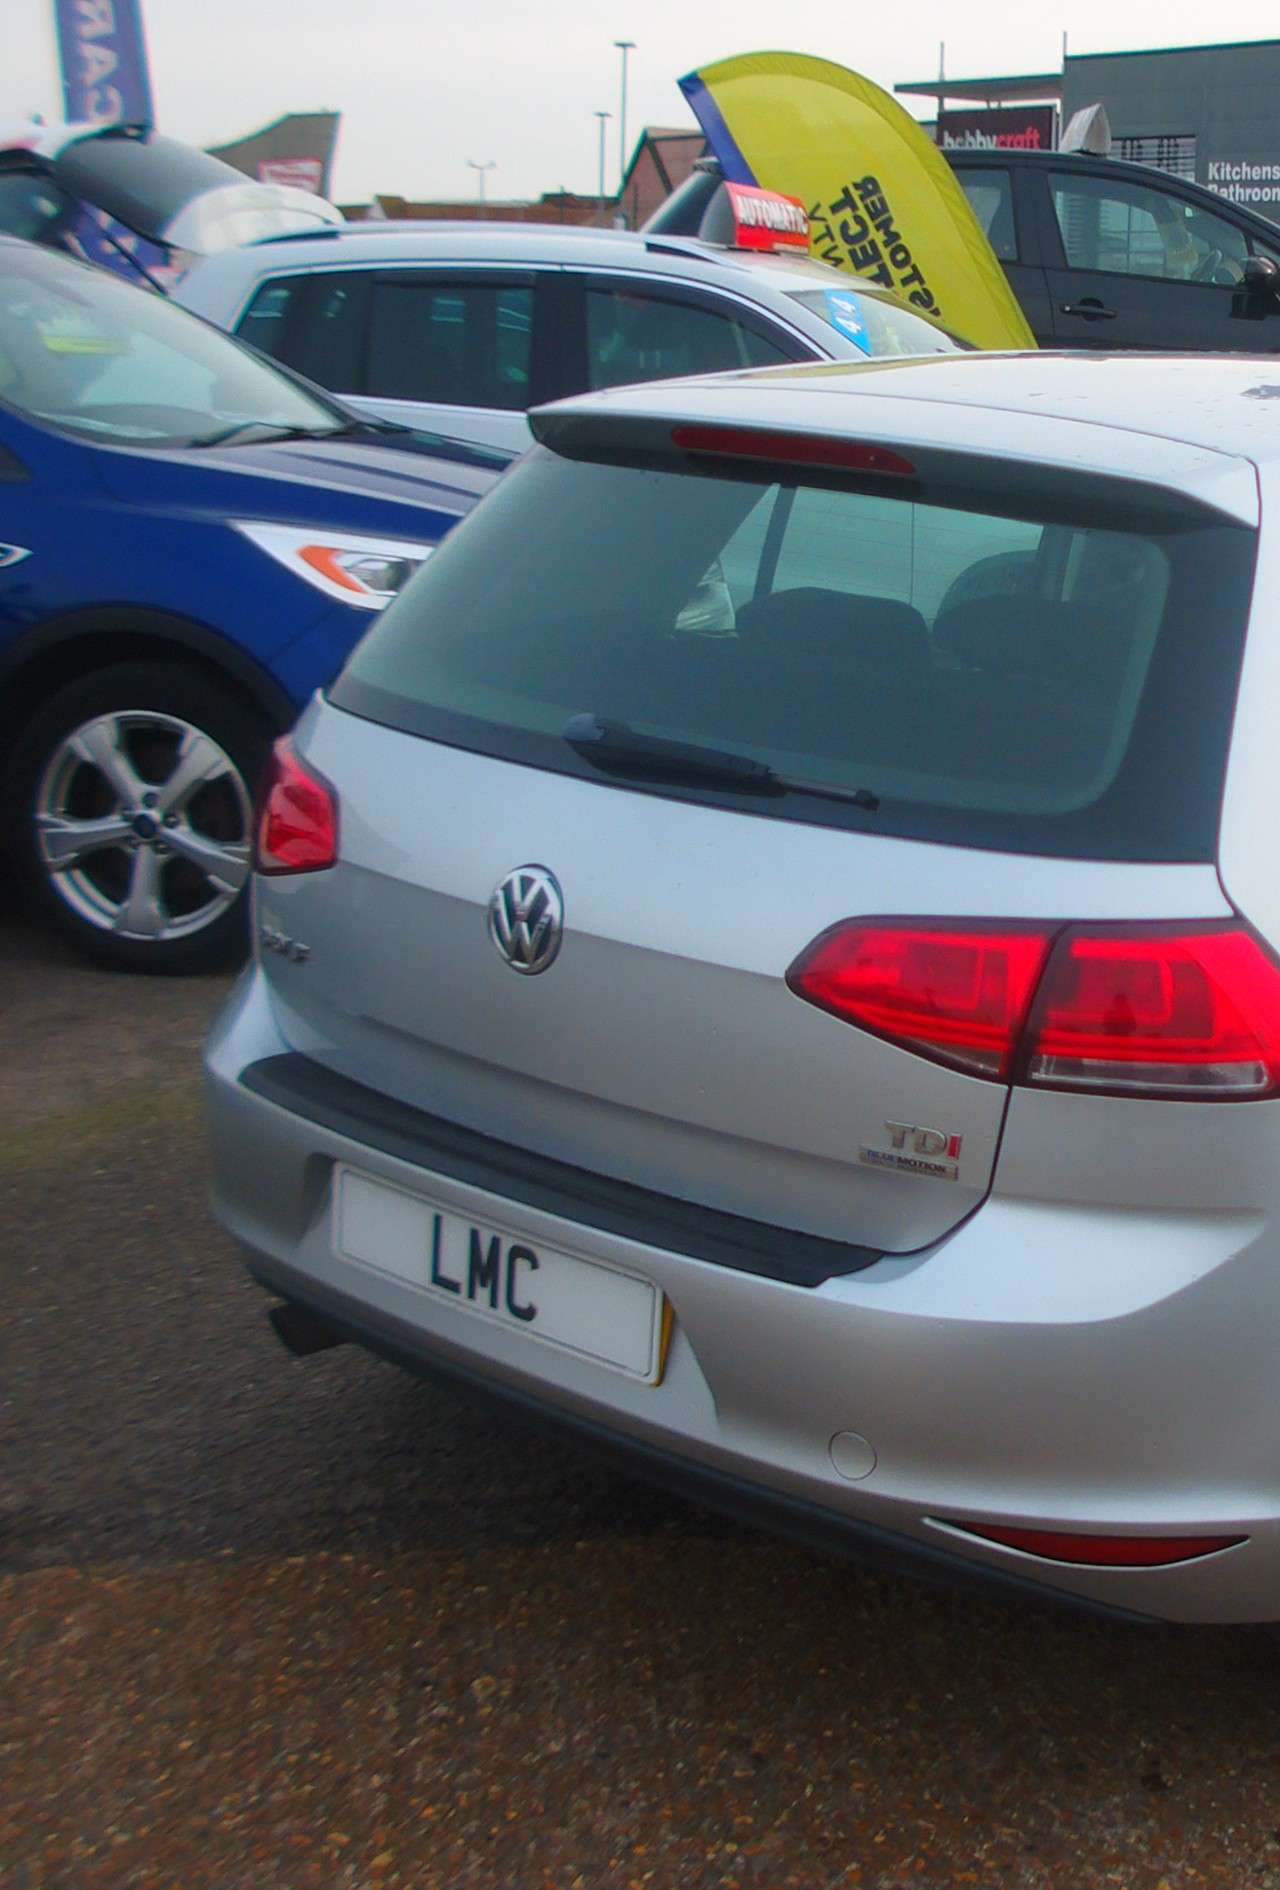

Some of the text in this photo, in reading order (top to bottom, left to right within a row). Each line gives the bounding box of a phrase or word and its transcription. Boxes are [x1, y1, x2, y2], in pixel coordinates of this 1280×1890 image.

[1208, 162, 1280, 180] Kitchens
[884, 1119, 962, 1160] TDI
[431, 1213, 540, 1322] LMC
